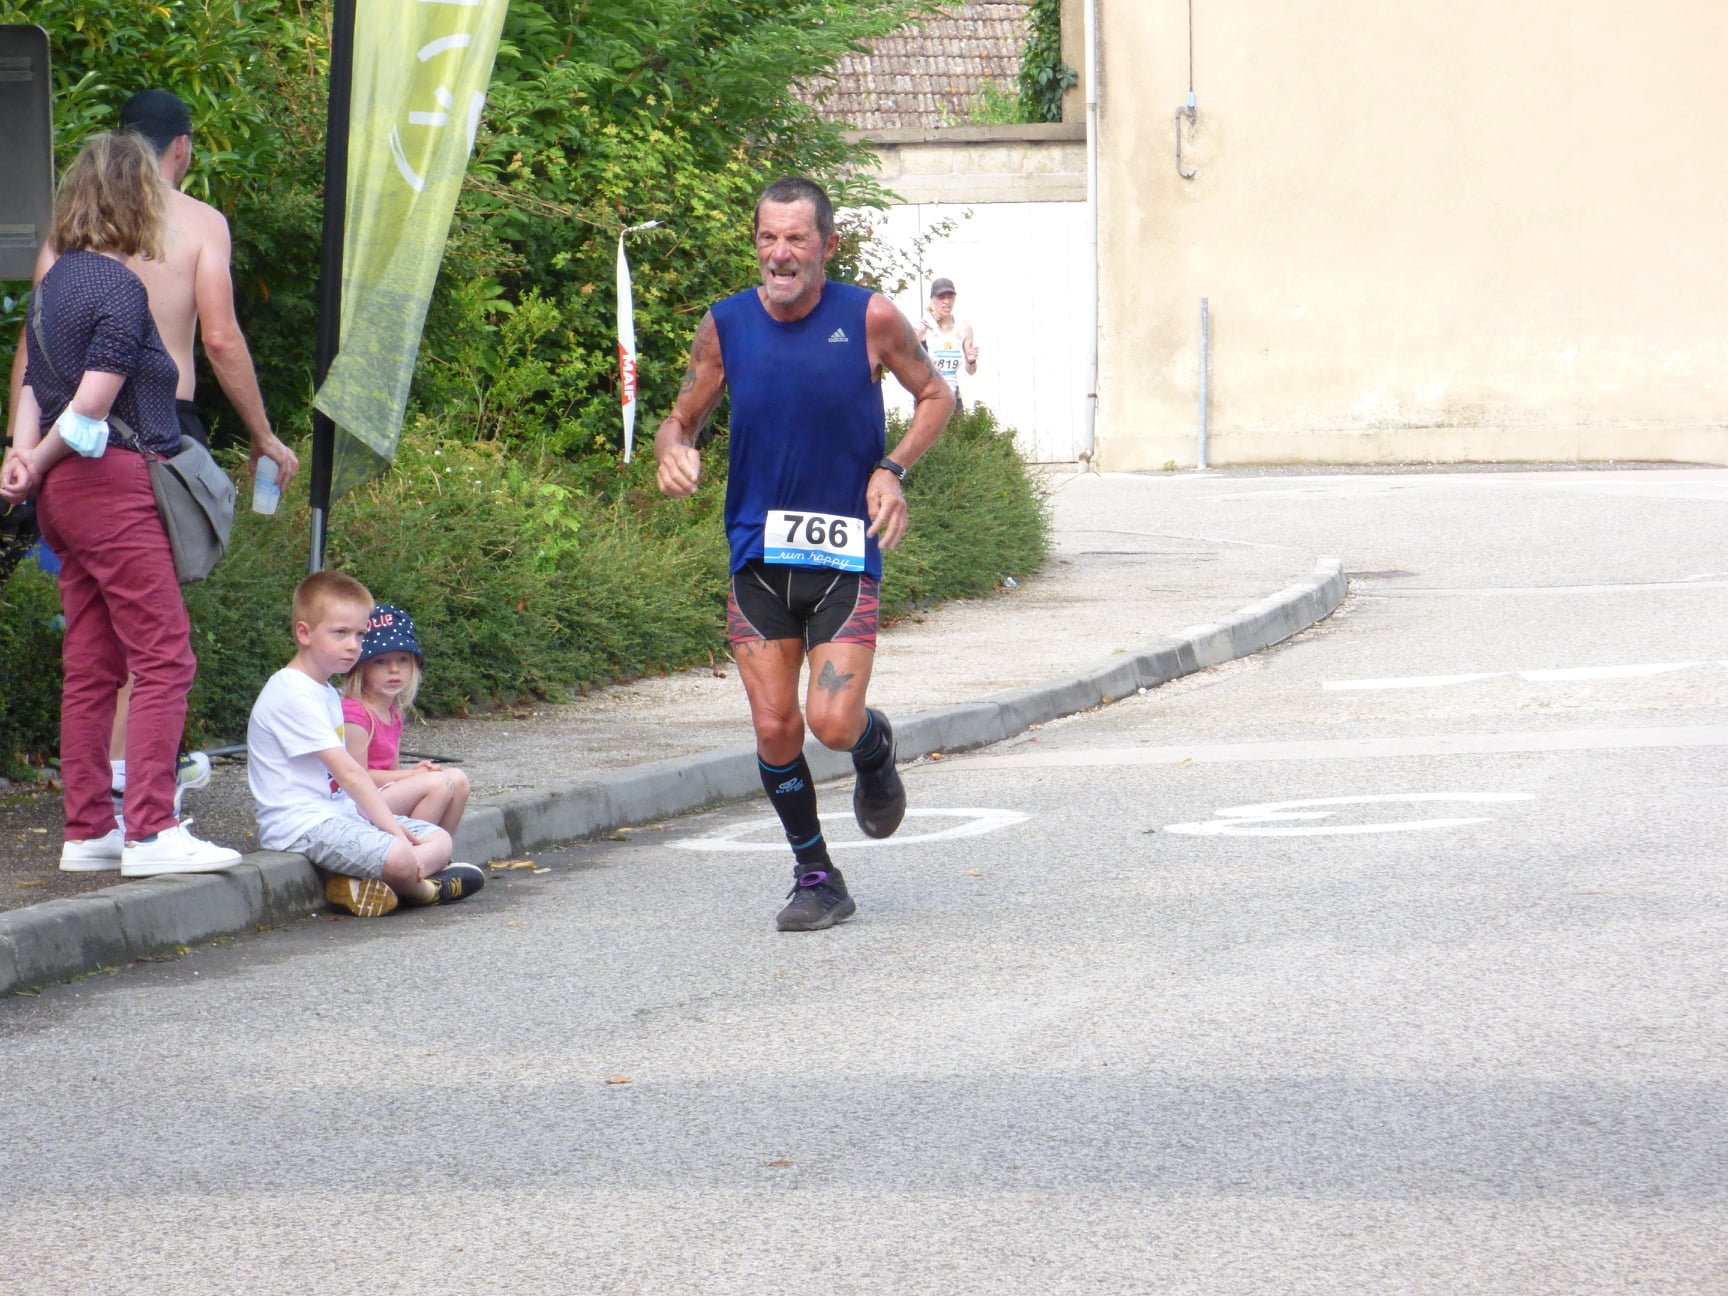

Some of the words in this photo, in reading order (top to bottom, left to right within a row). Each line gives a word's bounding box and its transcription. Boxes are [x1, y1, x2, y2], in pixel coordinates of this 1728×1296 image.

[937, 359, 959, 369] 819
[622, 354, 636, 401] MAIF
[783, 514, 848, 548] 766
[779, 551, 805, 560] run
[808, 553, 850, 569] happy
